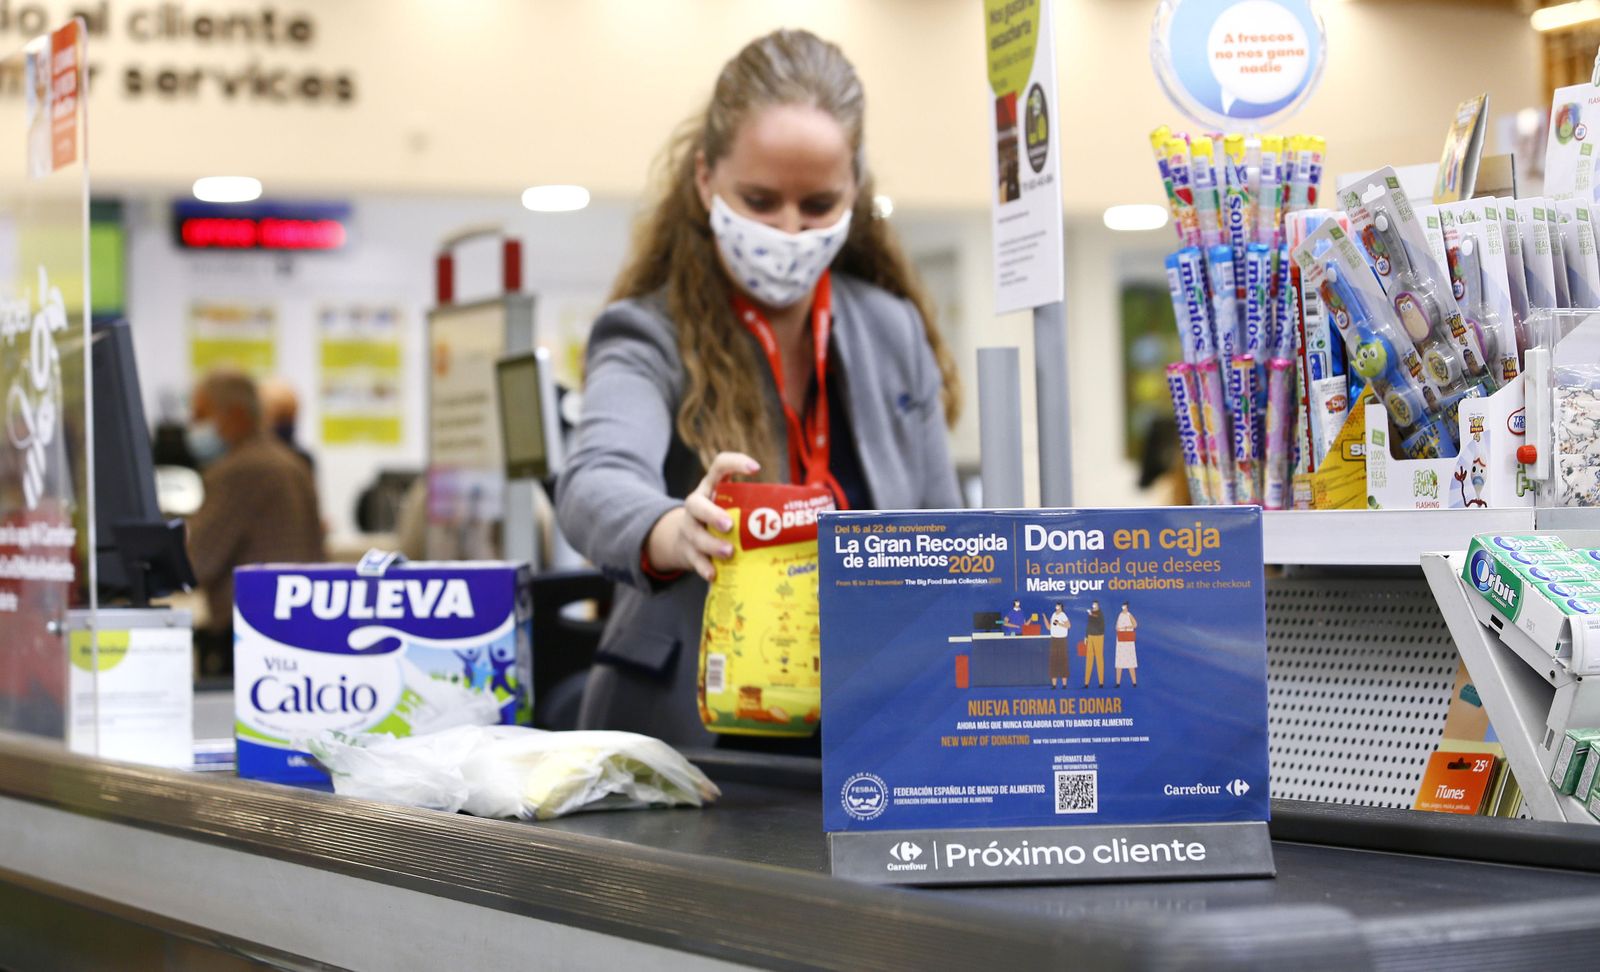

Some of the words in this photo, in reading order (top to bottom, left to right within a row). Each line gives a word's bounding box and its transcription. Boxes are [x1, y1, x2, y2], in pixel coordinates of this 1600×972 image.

[126, 8, 314, 43] cliente
[1224, 33, 1234, 44] A
[1238, 32, 1294, 44] frescos
[1215, 51, 1233, 60] no
[1237, 49, 1263, 58] nos
[1267, 48, 1304, 60] gana
[1240, 61, 1282, 74] nadie
[122, 63, 357, 102] services
[1182, 262, 1205, 351] mentos
[1248, 261, 1261, 350] mentos
[1174, 376, 1198, 466] mentos
[1232, 369, 1246, 459] mentos
[1469, 416, 1484, 427] TOY
[1371, 450, 1385, 460] 100%
[1371, 472, 1386, 480] REAL
[1371, 480, 1387, 488] FRUIT
[1416, 501, 1440, 509] FLASHING
[835, 525, 849, 533] Del
[852, 525, 861, 533] 16
[863, 525, 871, 533] al
[885, 524, 896, 532] de
[900, 524, 946, 532] noviembre
[835, 536, 859, 553] La
[864, 535, 906, 552] Gran
[916, 534, 1008, 556] Recogida
[1024, 524, 1104, 551] Dona
[1113, 528, 1150, 549] en
[1159, 522, 1220, 557] caja
[843, 554, 863, 568] de
[868, 553, 948, 567] alimentos
[949, 555, 994, 573] 2020
[1026, 559, 1040, 575] la
[1045, 557, 1120, 575] cantidad
[1125, 560, 1158, 577] que
[1163, 556, 1221, 573] desees
[917, 578, 927, 587] Big
[958, 577, 988, 585] Collection
[1027, 577, 1066, 592] Make
[1070, 578, 1104, 595] your
[1108, 576, 1184, 591] donations
[1186, 581, 1195, 589] at
[1196, 580, 1210, 589] the
[1212, 579, 1251, 589] checkout
[1471, 549, 1517, 607] Orbit
[274, 575, 474, 620] PULEVA
[250, 674, 378, 714] Calcio
[968, 699, 1010, 716] NUEVA
[1013, 698, 1056, 716] FORMA
[1059, 698, 1075, 715] DE
[1079, 697, 1122, 714] DONAR
[957, 721, 976, 730] AHORA
[977, 720, 989, 729] MÁS
[991, 721, 1002, 729] QUE
[1003, 720, 1022, 729] NUNCA
[1023, 720, 1052, 729] COLABORA
[1053, 719, 1064, 728] CON
[1065, 719, 1073, 728] TU
[1073, 719, 1092, 728] BANCO
[1093, 718, 1101, 727] DE
[1102, 718, 1133, 727] ALIMENTOS
[941, 736, 959, 747] NEW
[961, 736, 977, 746] WAY
[979, 735, 989, 746] OF
[991, 734, 1030, 746] DONATING
[894, 786, 933, 796] FEDERACIÓN
[934, 785, 966, 795] ESPAÑOLA
[967, 786, 976, 795] DE
[977, 786, 998, 795] BANCO
[1000, 785, 1008, 794] DE
[1009, 784, 1045, 794] ALIMENTOS
[1164, 783, 1221, 796] Carrefour
[1436, 784, 1465, 800] iTunes
[946, 840, 1086, 867] Próximo
[1093, 838, 1206, 865] cliente
[887, 863, 927, 871] Carrefour
